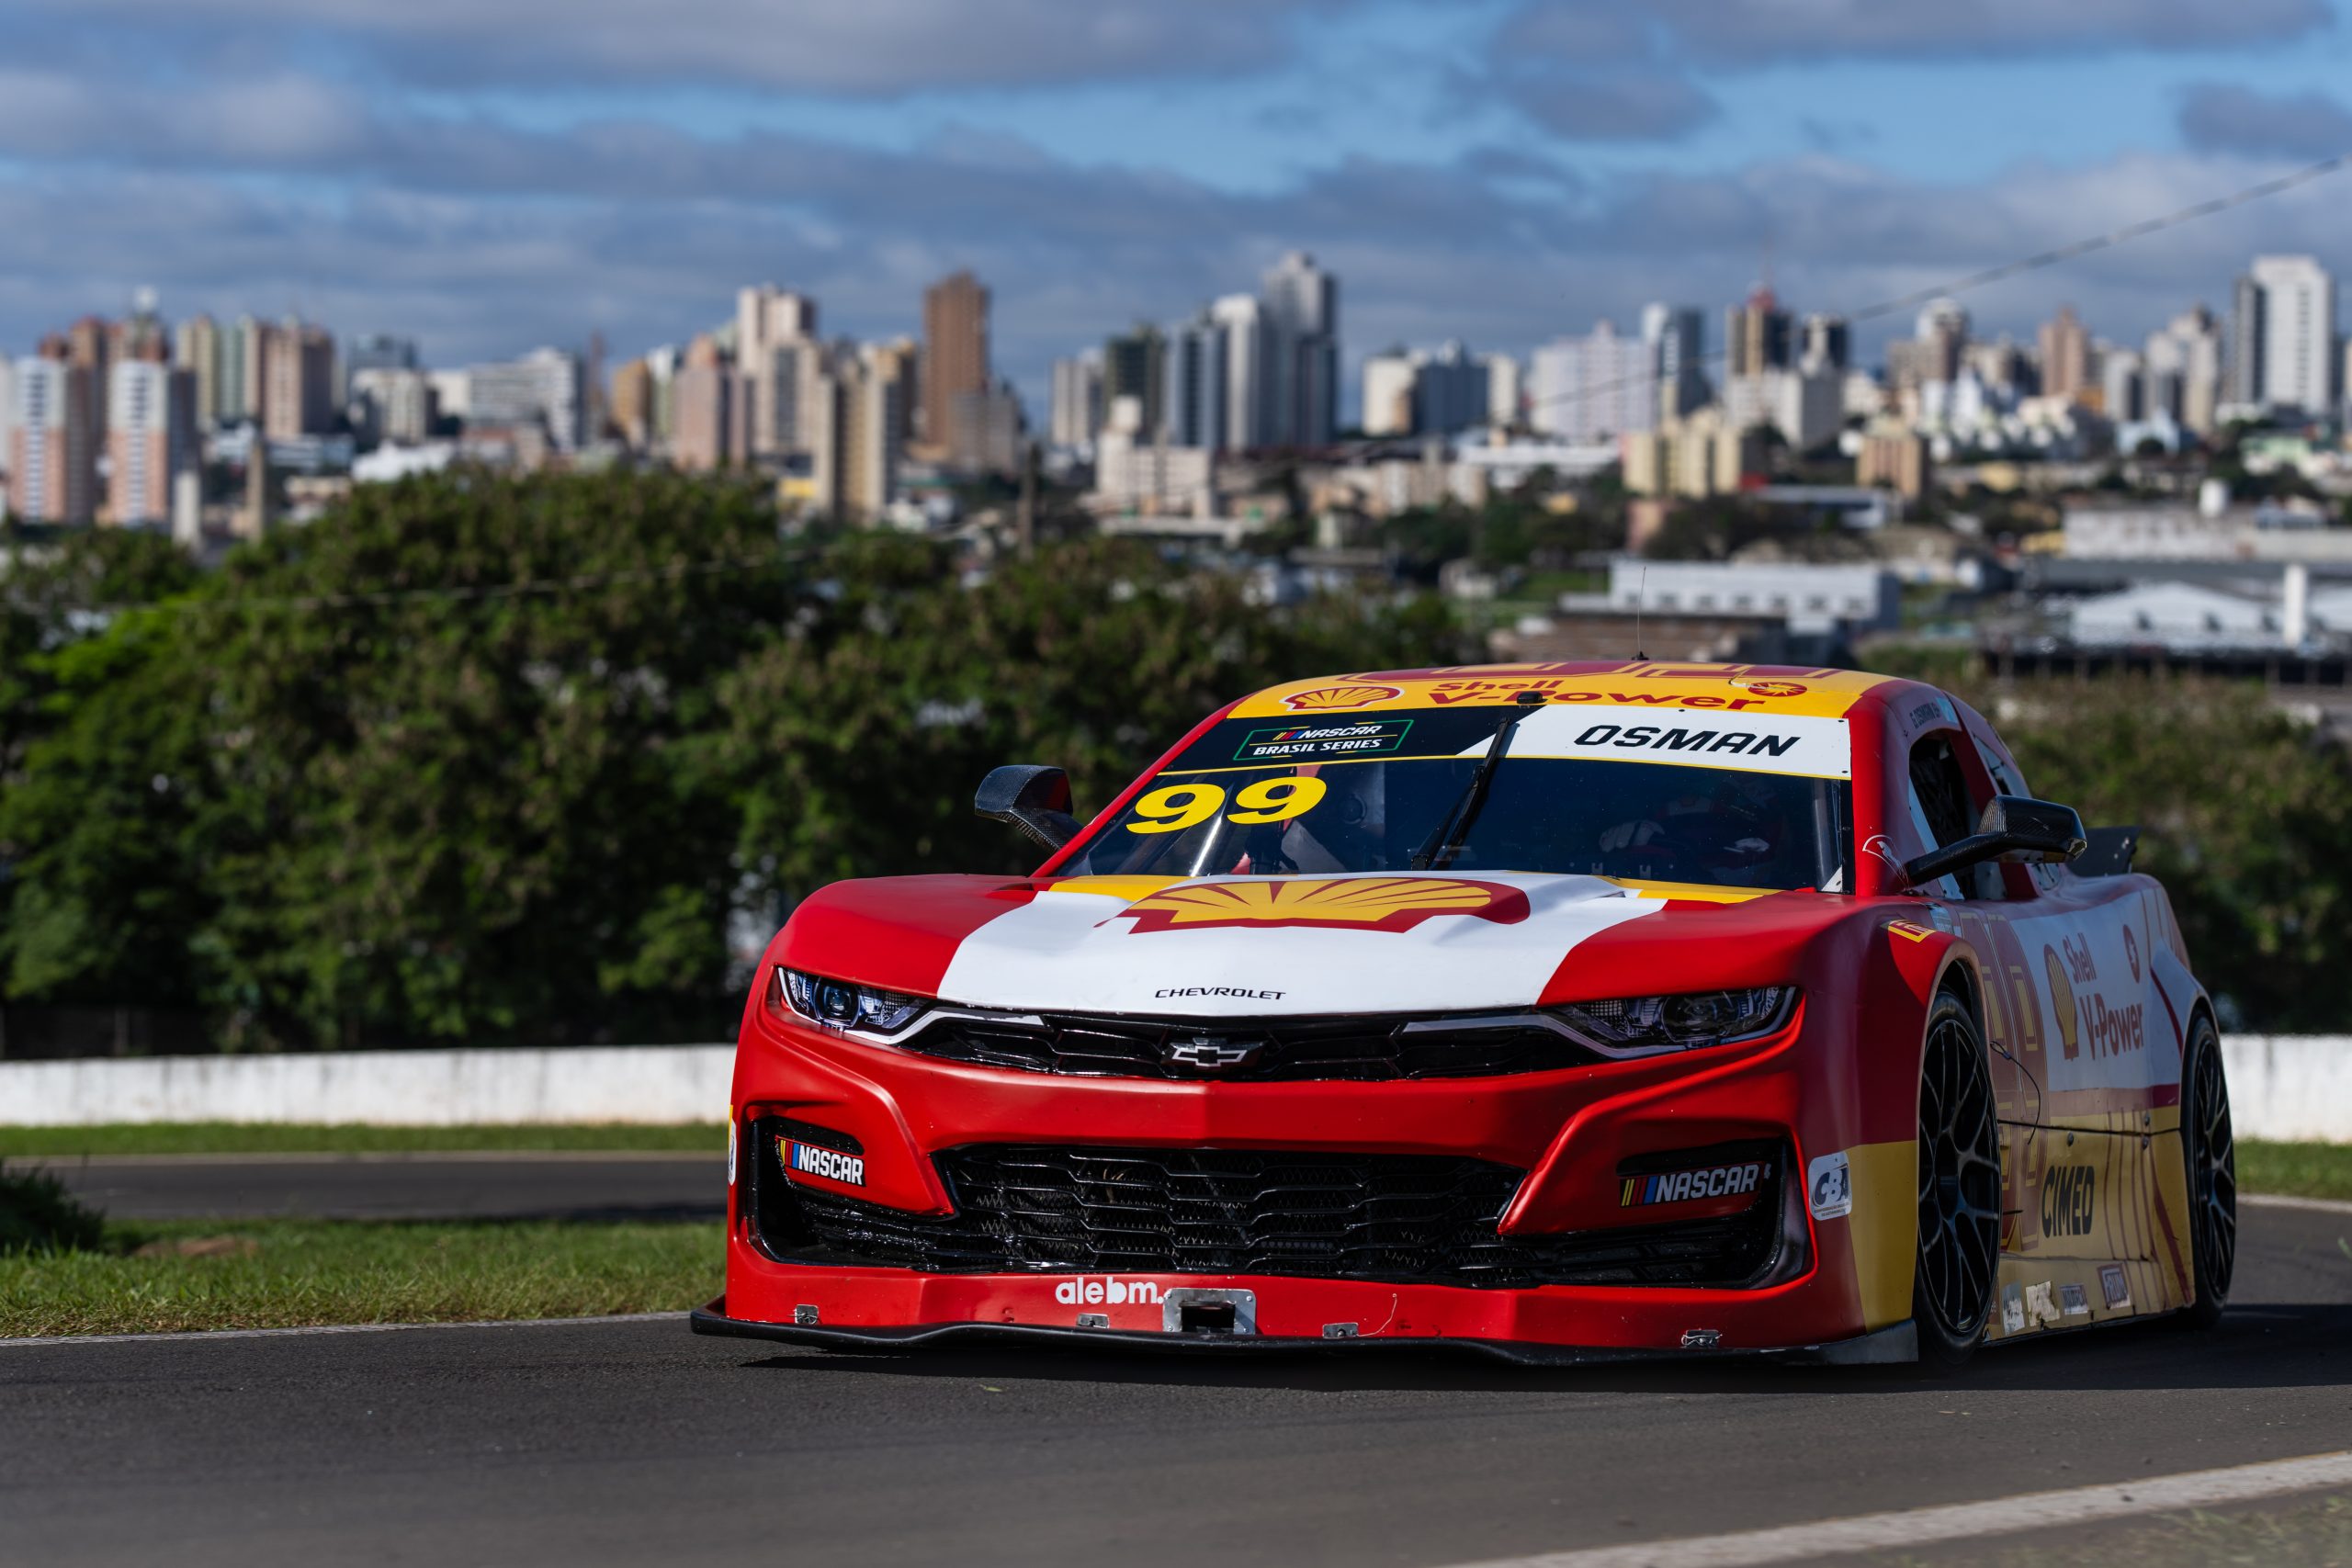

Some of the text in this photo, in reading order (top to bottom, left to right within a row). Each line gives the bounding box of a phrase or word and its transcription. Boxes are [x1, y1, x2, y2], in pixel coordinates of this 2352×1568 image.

[1428, 690, 1766, 711] V-Power
[1431, 680, 1565, 692] Shell
[1252, 739, 1383, 756] BRASIL SERIES
[1298, 725, 1383, 739] NASCAR
[1573, 724, 1801, 758] OSMAN
[1125, 776, 1328, 834] 99
[2062, 931, 2098, 985] Shell
[1154, 987, 1286, 1000] CHEVROLET
[2078, 992, 2144, 1061] V-Power
[798, 1144, 864, 1186] NASCAR
[1654, 1163, 1760, 1203] NASCAR
[2041, 1165, 2096, 1238] CIMED
